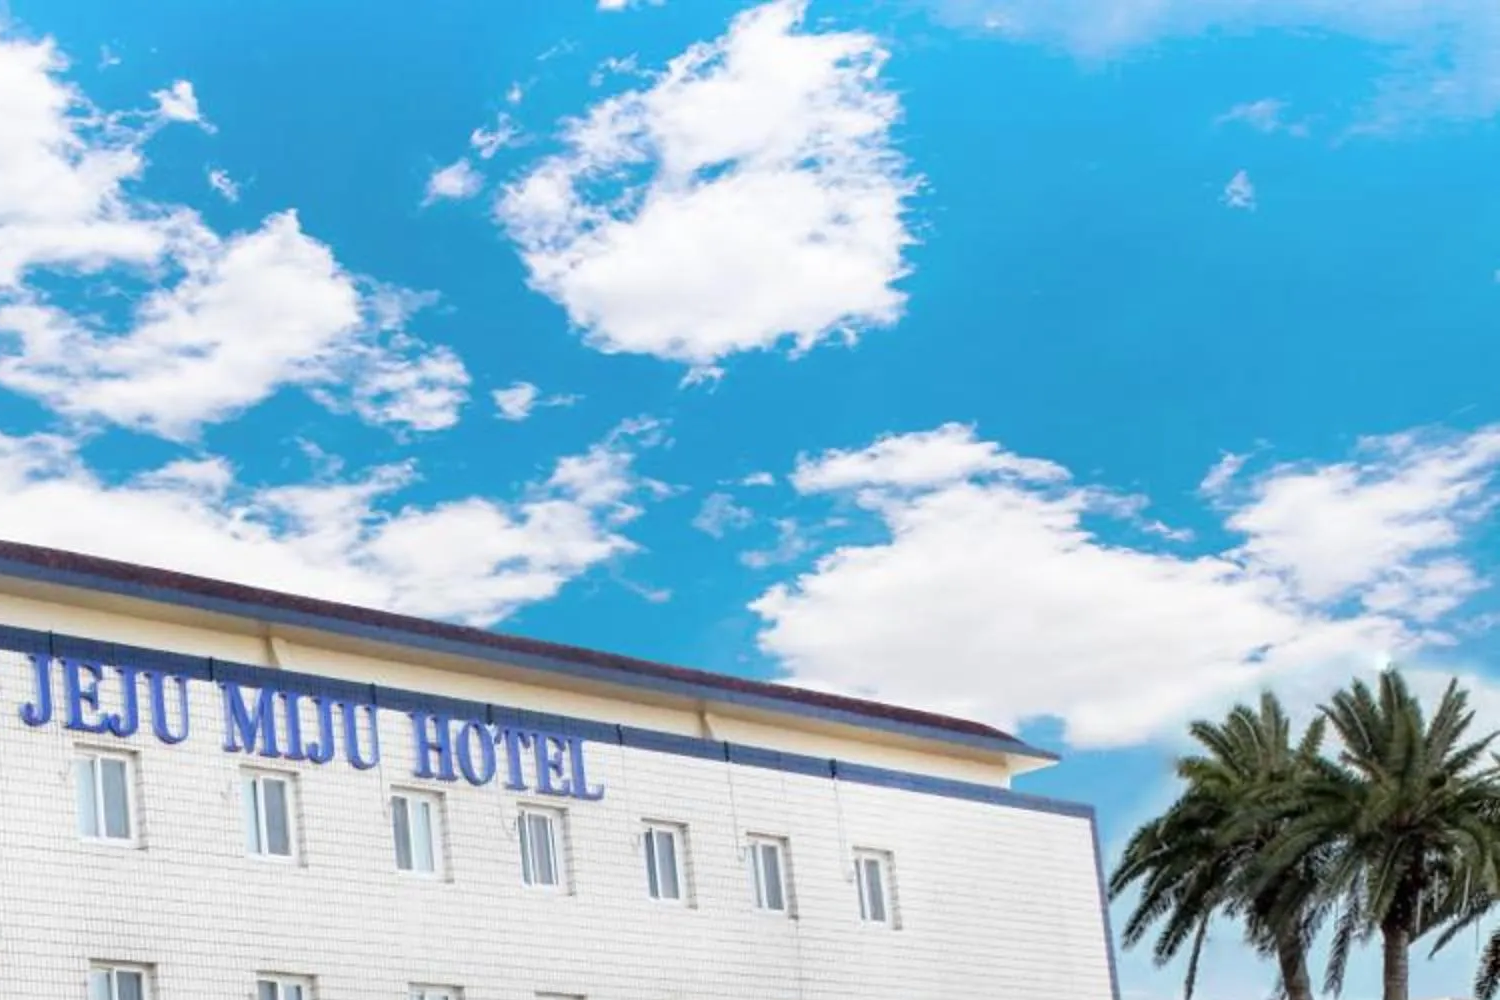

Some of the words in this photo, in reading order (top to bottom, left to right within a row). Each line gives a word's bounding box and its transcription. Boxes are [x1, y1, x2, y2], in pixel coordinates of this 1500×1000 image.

[19, 653, 189, 744] JEJU
[218, 679, 380, 770] MIJU
[409, 711, 605, 800] HOTEL
